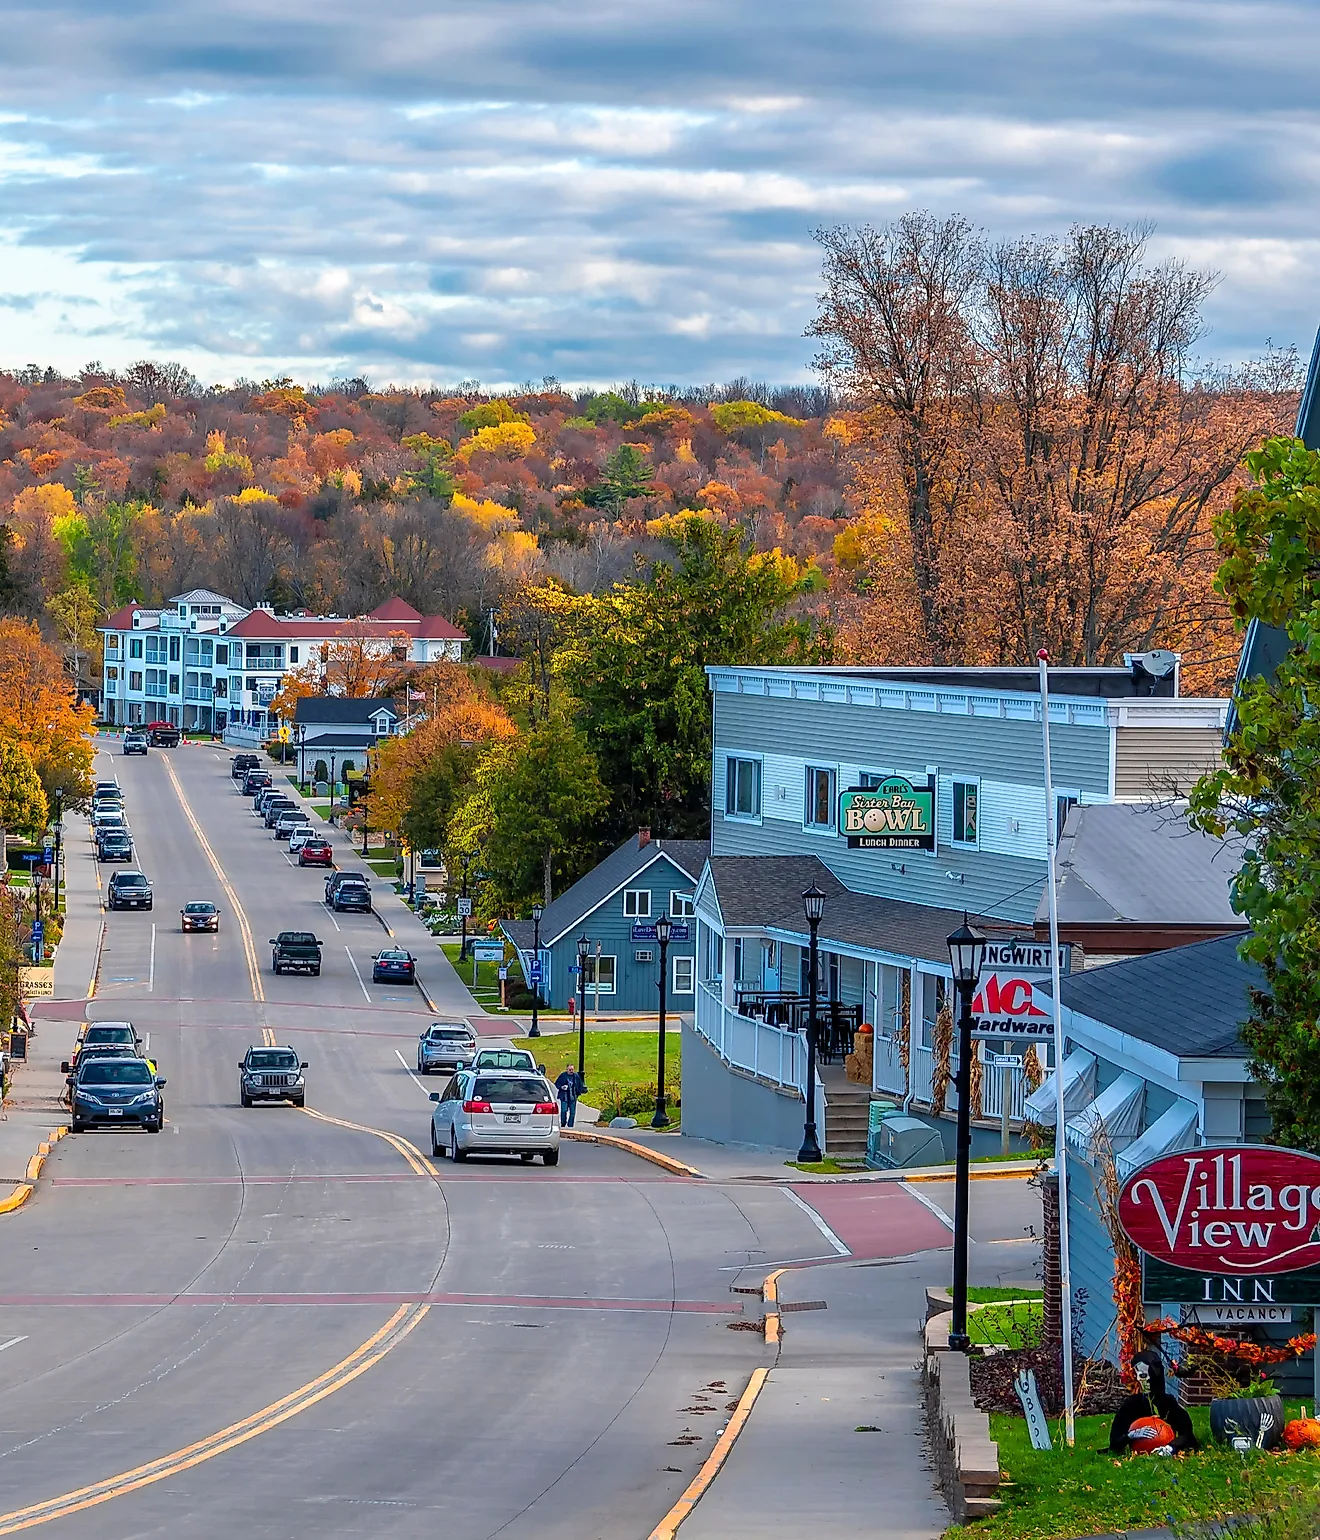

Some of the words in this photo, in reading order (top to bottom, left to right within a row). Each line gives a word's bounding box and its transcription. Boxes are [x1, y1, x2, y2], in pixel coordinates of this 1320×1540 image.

[883, 784, 908, 794] EARL'S
[852, 795, 888, 808] Sister
[892, 795, 914, 813] Bay
[846, 808, 926, 832] BOWL
[859, 838, 887, 847] LUNCH
[889, 838, 920, 847] DINNER
[1201, 1277, 1276, 1302] INN
[1215, 1308, 1287, 1320] VACANCY
